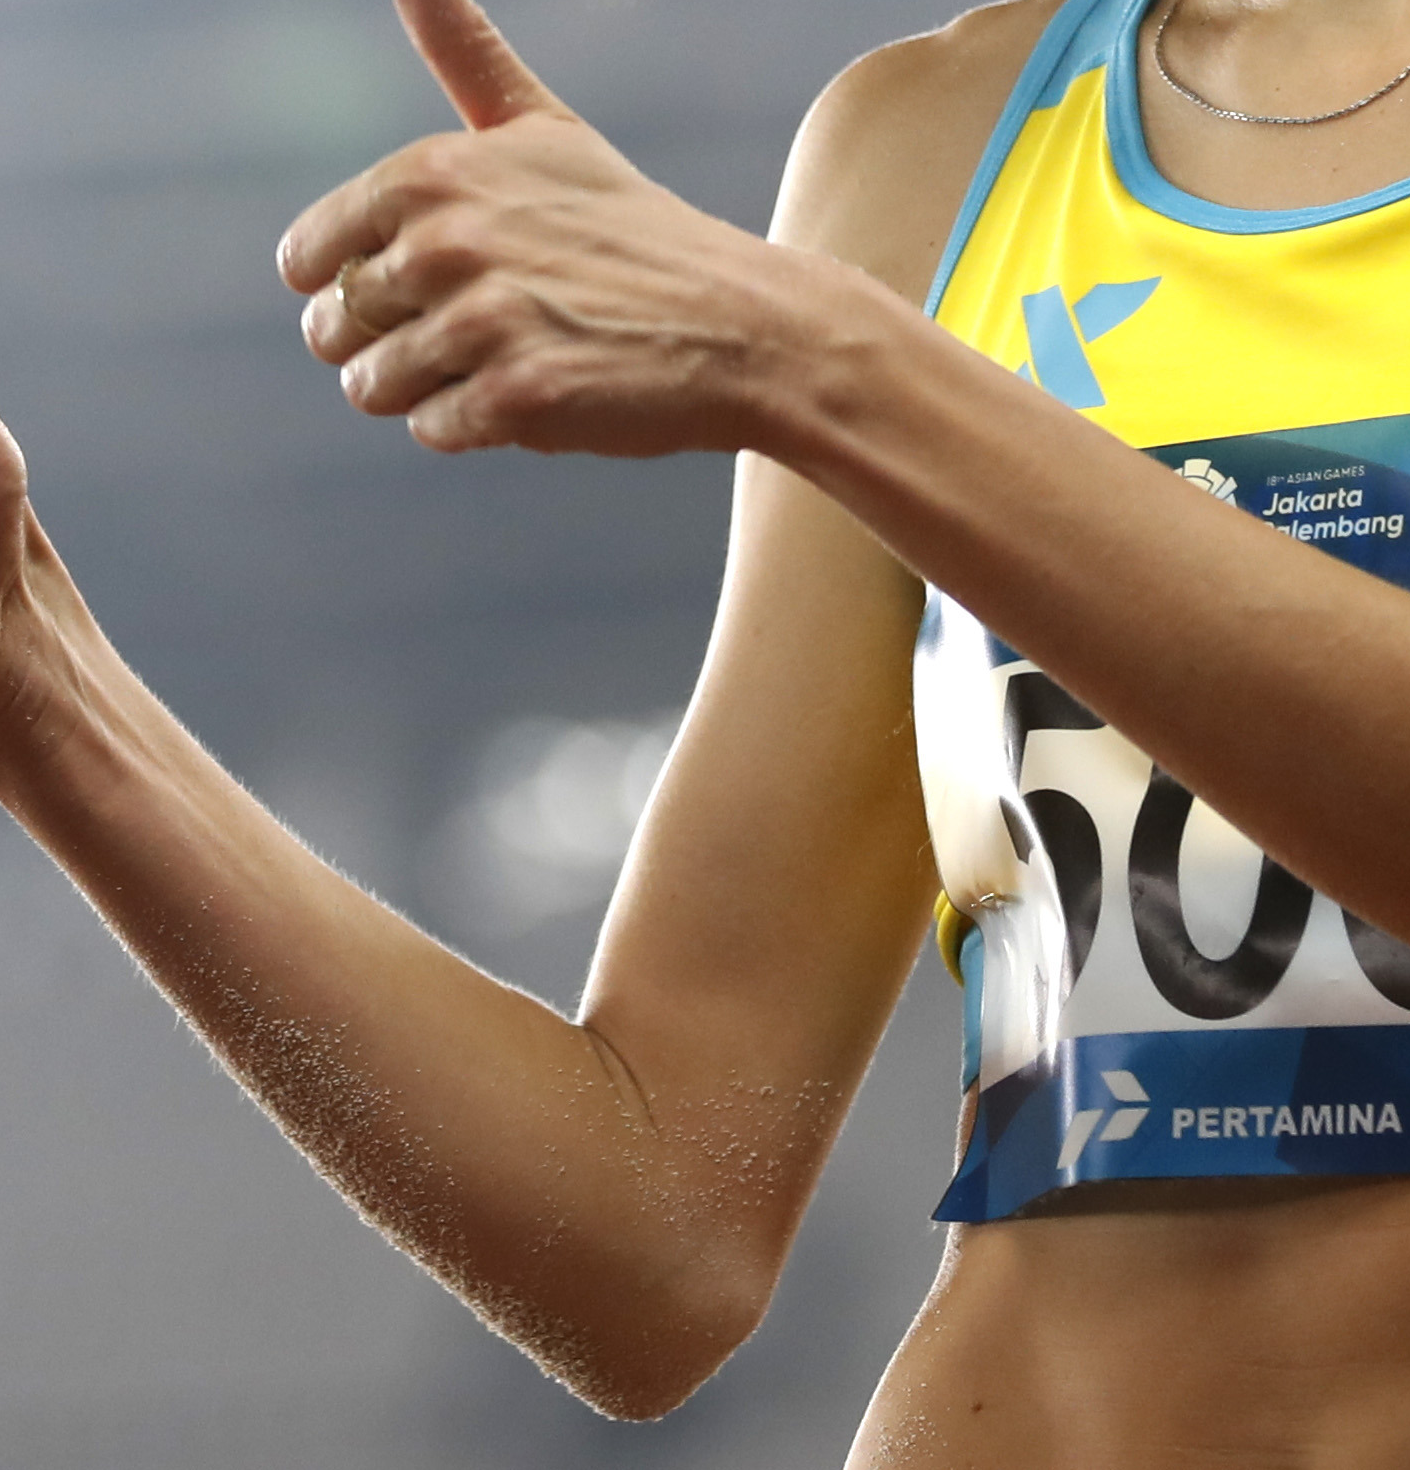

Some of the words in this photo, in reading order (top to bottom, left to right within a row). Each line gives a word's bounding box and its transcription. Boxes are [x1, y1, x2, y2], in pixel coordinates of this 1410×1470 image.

[1287, 472, 1322, 484] ASIAN
[1323, 465, 1365, 480] GAMES
[1262, 487, 1363, 516] Jakarta
[1264, 514, 1404, 541] lembang
[1172, 1103, 1403, 1139] PERTAMINA
